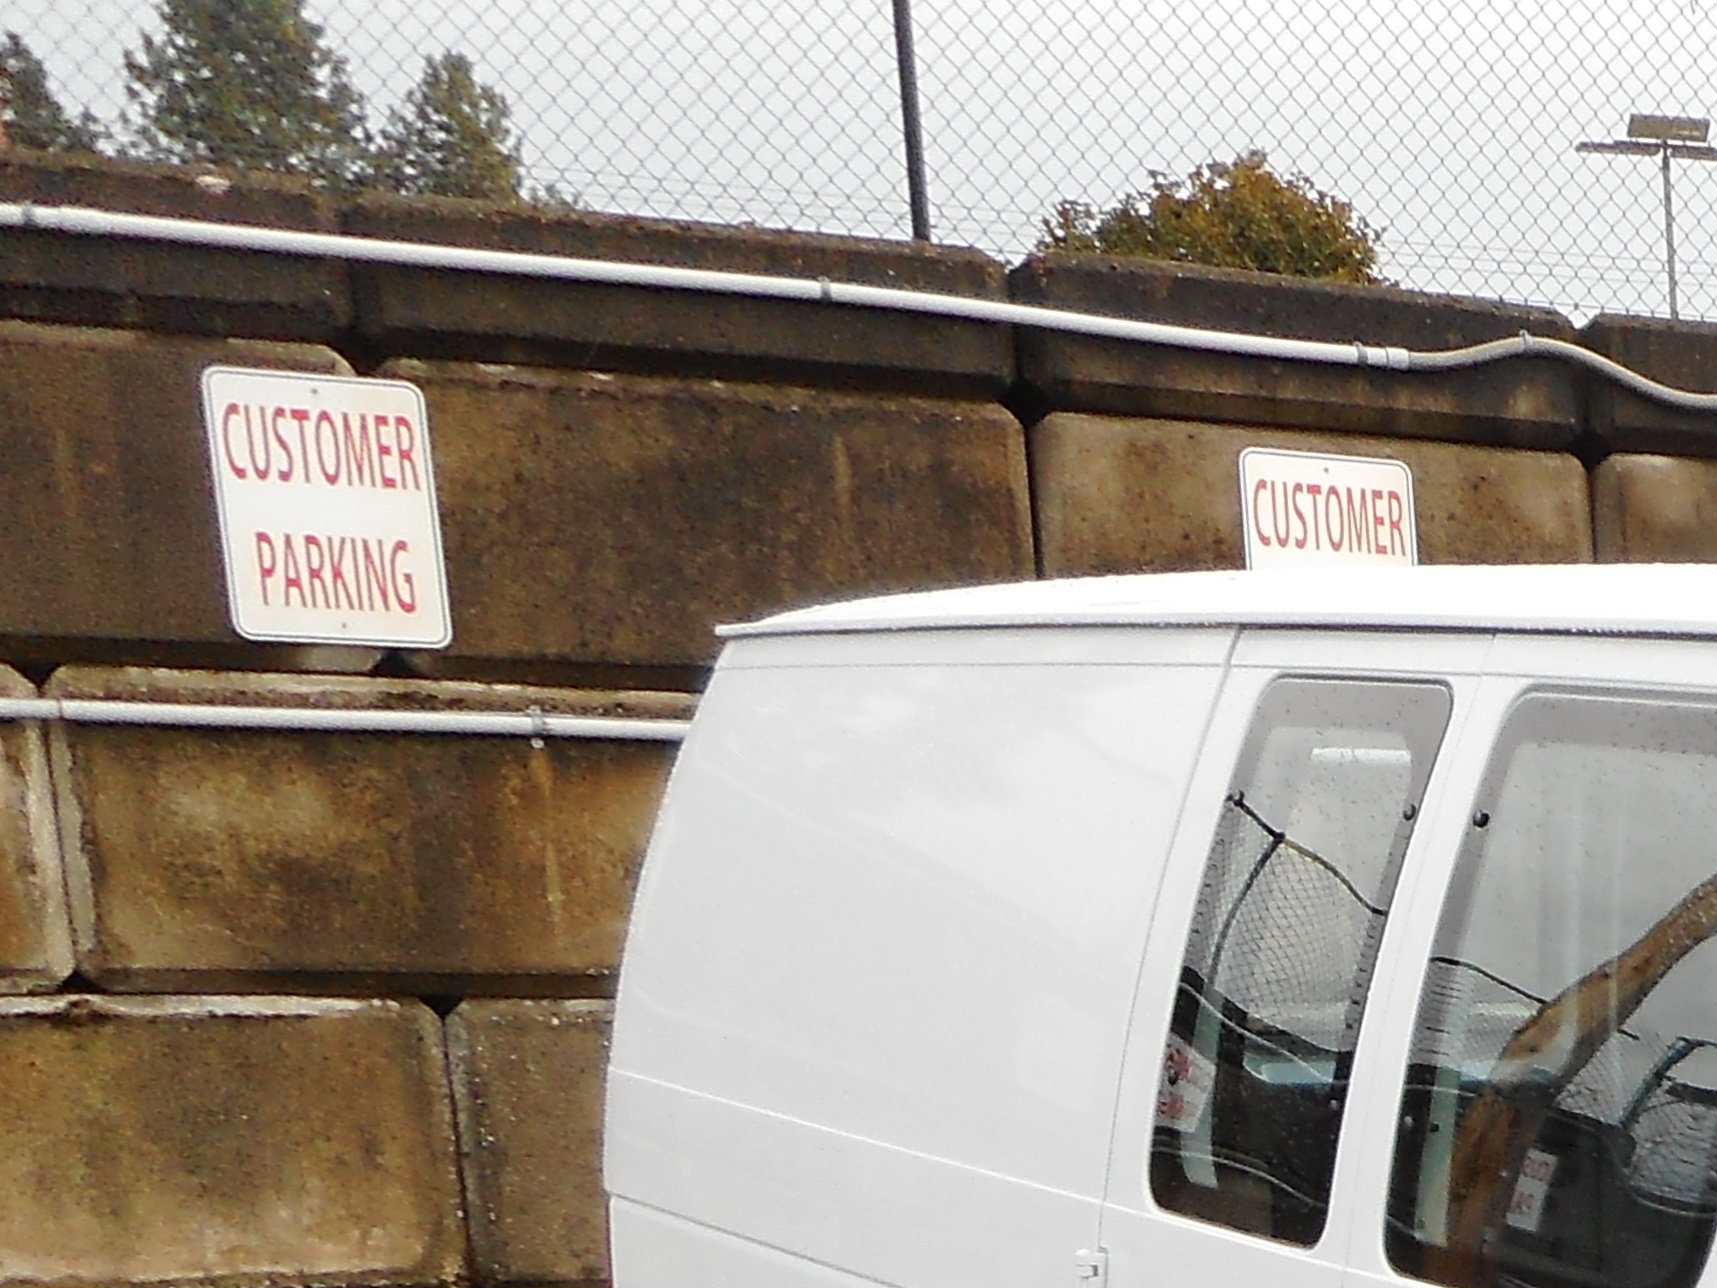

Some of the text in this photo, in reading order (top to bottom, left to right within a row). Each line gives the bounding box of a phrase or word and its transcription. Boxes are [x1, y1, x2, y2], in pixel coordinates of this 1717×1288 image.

[222, 402, 421, 491] CUSTOMER
[1253, 478, 1407, 557] CUSTOMER
[254, 531, 417, 613] PARKING
